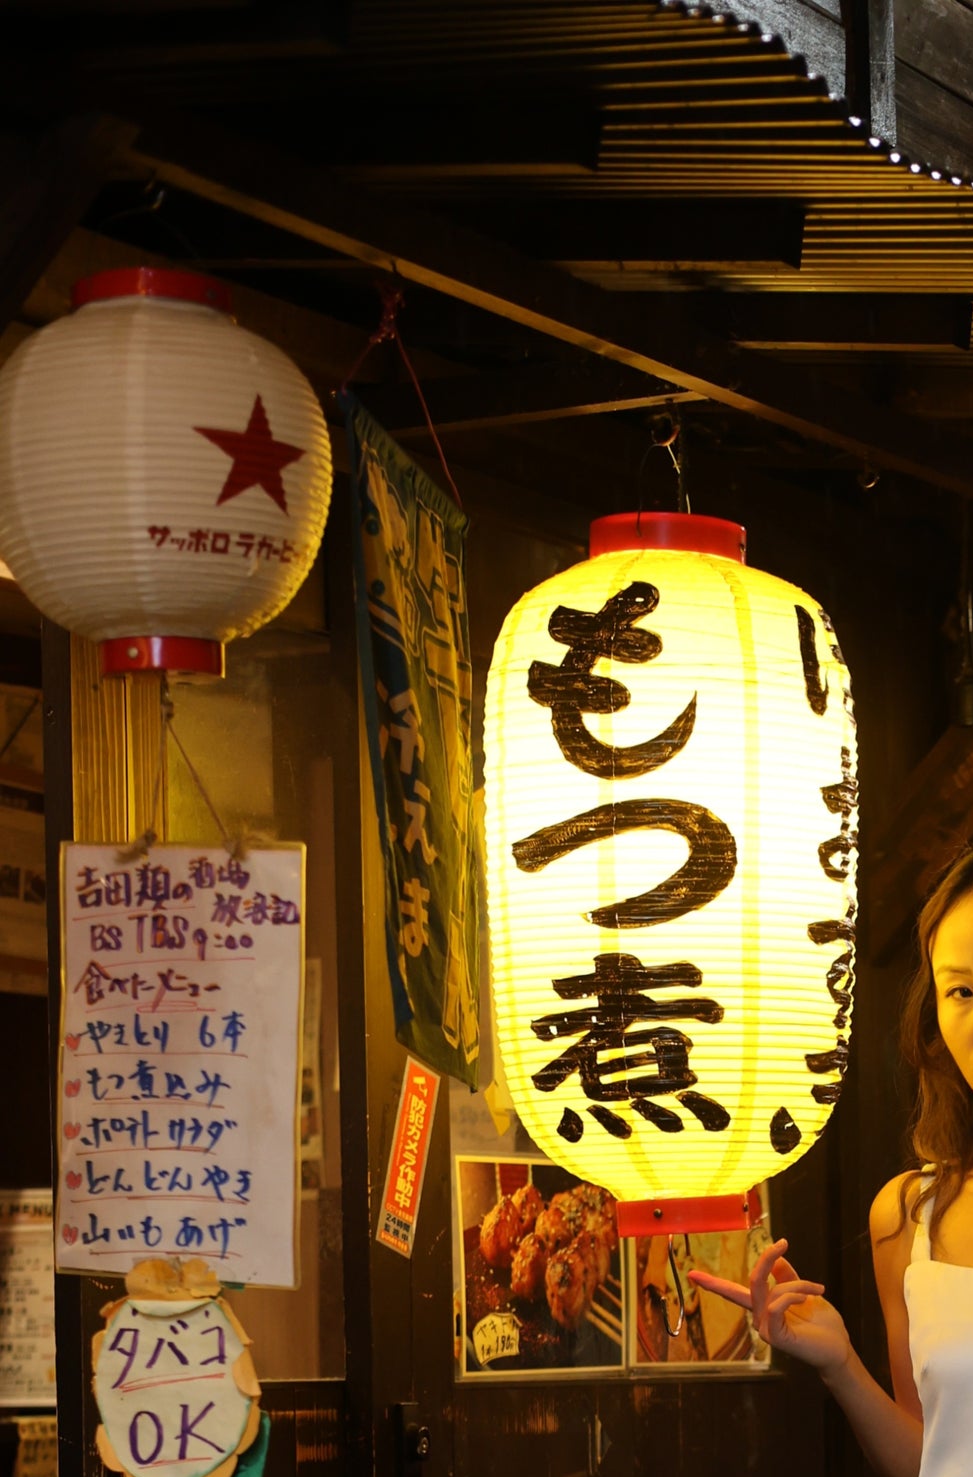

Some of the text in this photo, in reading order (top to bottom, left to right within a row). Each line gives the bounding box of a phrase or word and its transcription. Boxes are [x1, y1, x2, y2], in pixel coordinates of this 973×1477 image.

[511, 581, 738, 1143] もつ煮
[90, 924, 123, 952] BS
[128, 914, 189, 953] TBS
[395, 1095, 427, 1208] 防犯カメラ作動中
[109, 1319, 228, 1389] タバコ
[129, 1401, 226, 1465] OK
